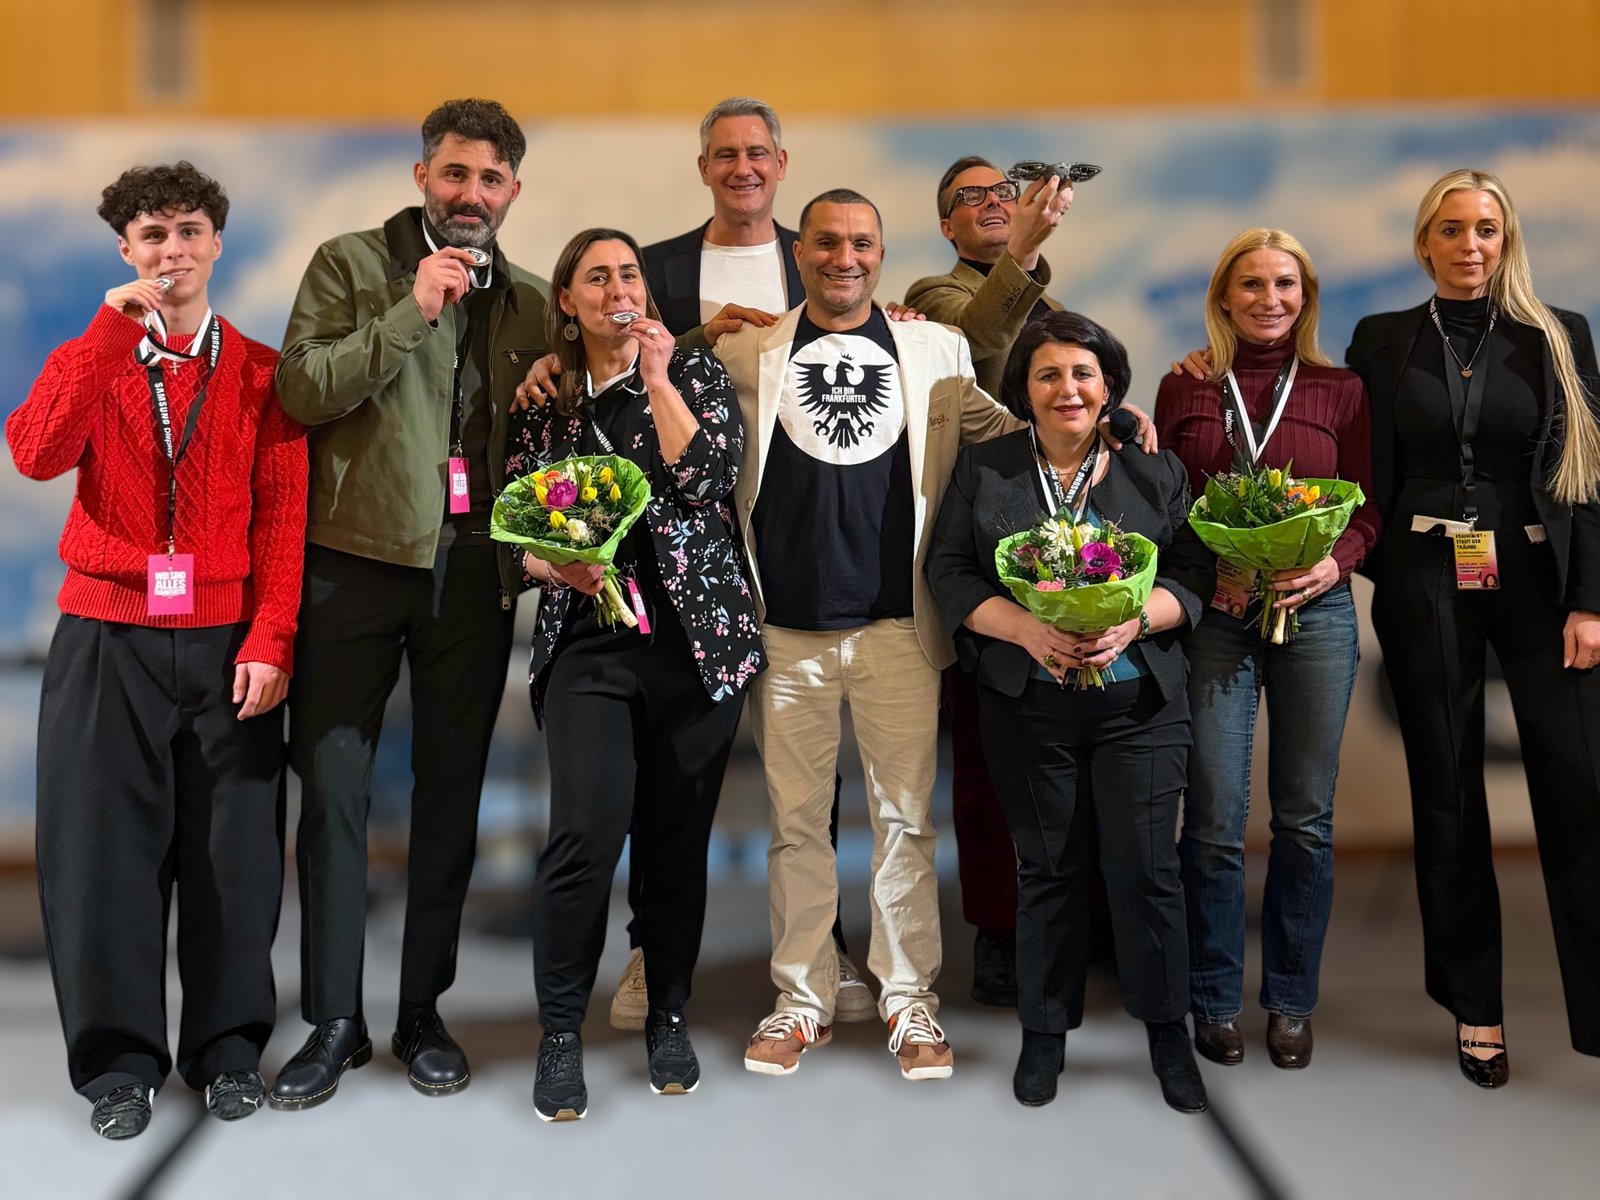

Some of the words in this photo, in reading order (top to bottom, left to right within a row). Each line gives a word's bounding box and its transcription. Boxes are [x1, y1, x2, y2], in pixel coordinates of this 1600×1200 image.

[831, 386, 843, 395] ICH
[843, 386, 855, 395] BIN
[821, 394, 867, 403] FRANKFURTER
[154, 382, 170, 425] SAMSUNG
[163, 427, 174, 459] Display
[1064, 471, 1085, 504] SAMSUNG
[1081, 448, 1096, 472] Displa
[155, 579, 186, 590] ALLES
